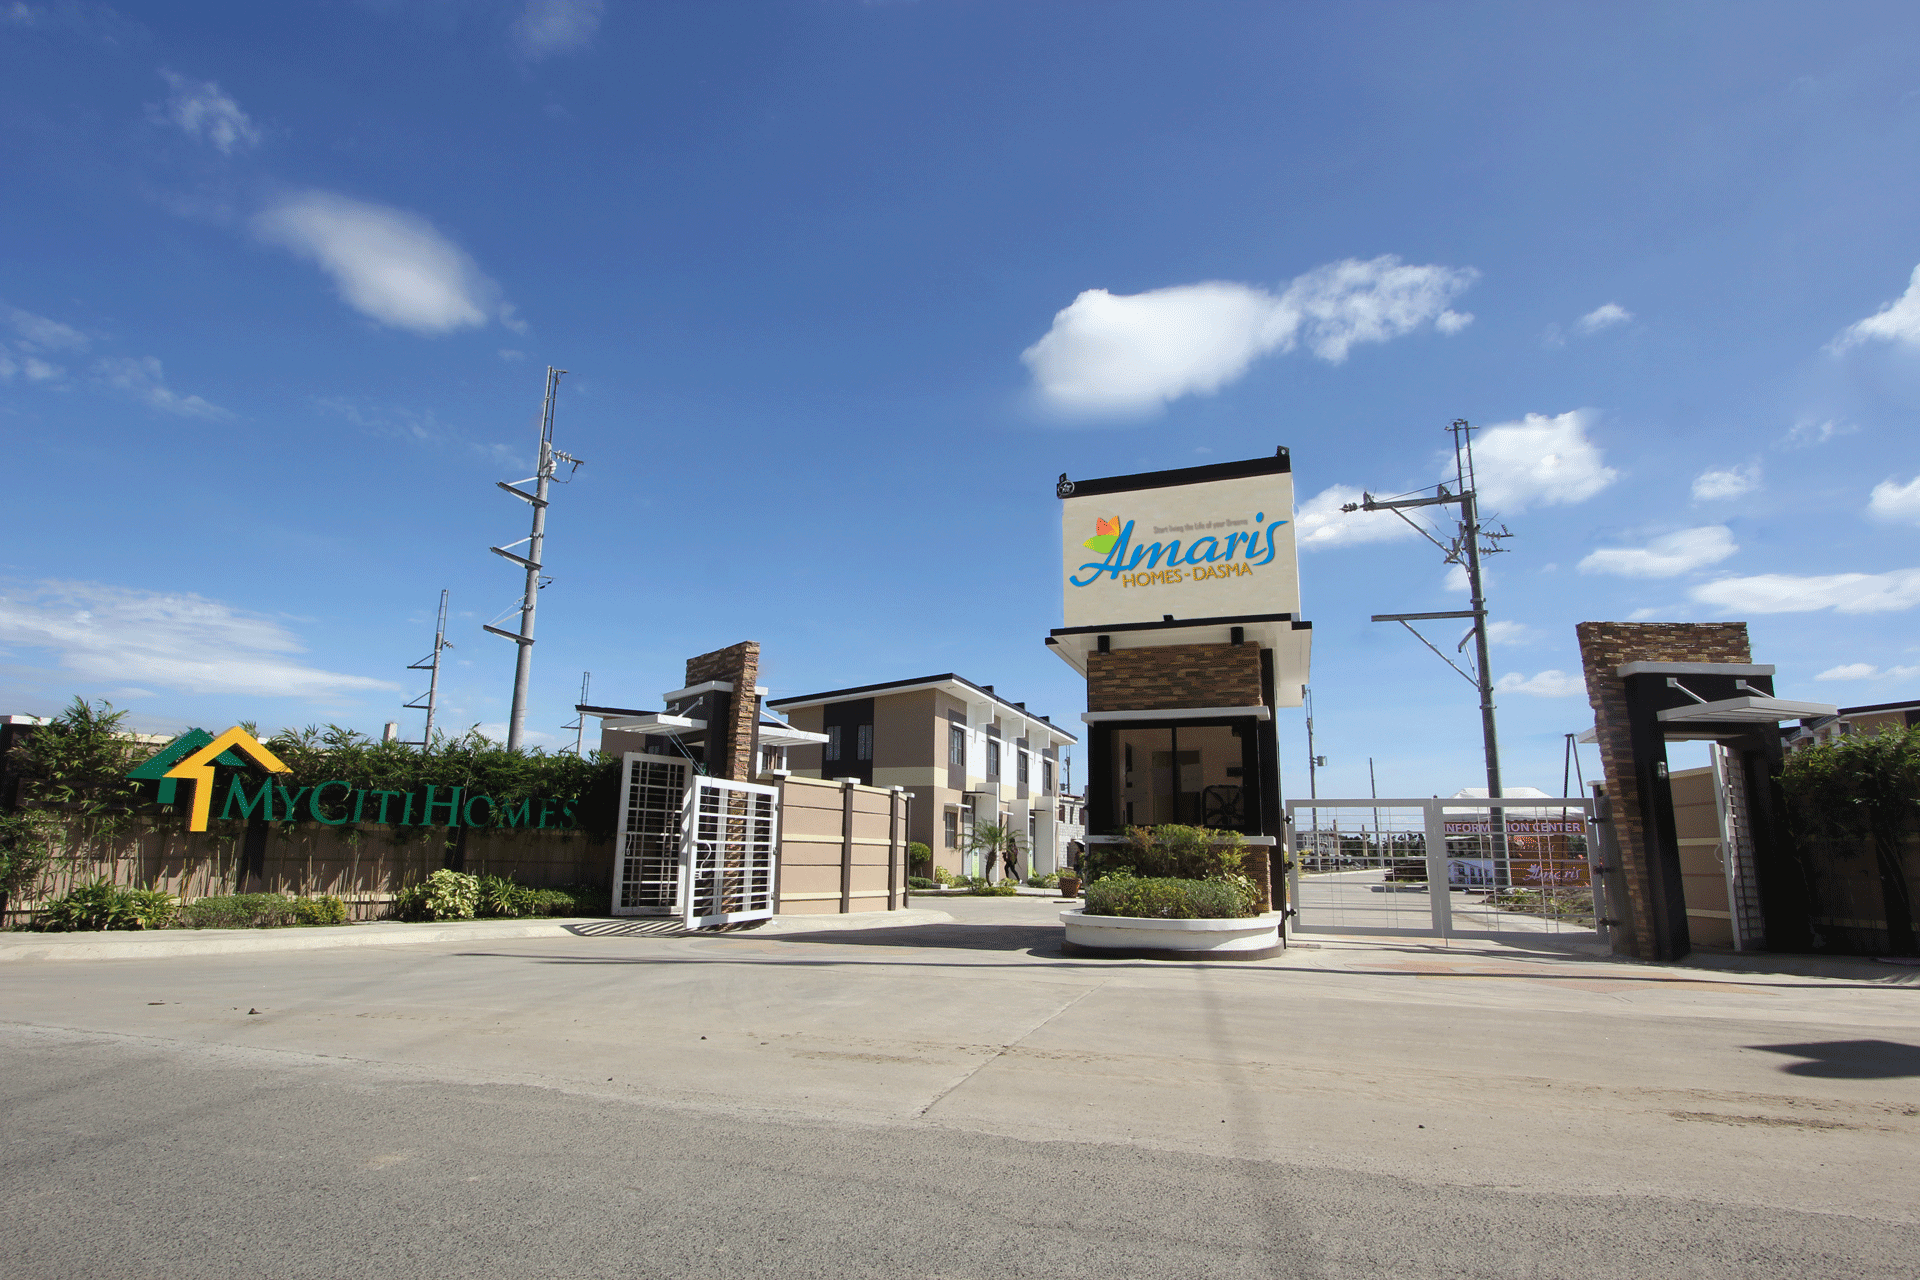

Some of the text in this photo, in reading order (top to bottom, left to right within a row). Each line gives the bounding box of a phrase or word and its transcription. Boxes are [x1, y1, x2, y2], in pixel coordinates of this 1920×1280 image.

[1069, 512, 1289, 586] Amaris
[1444, 822, 1580, 833] INFORMION CENTER
